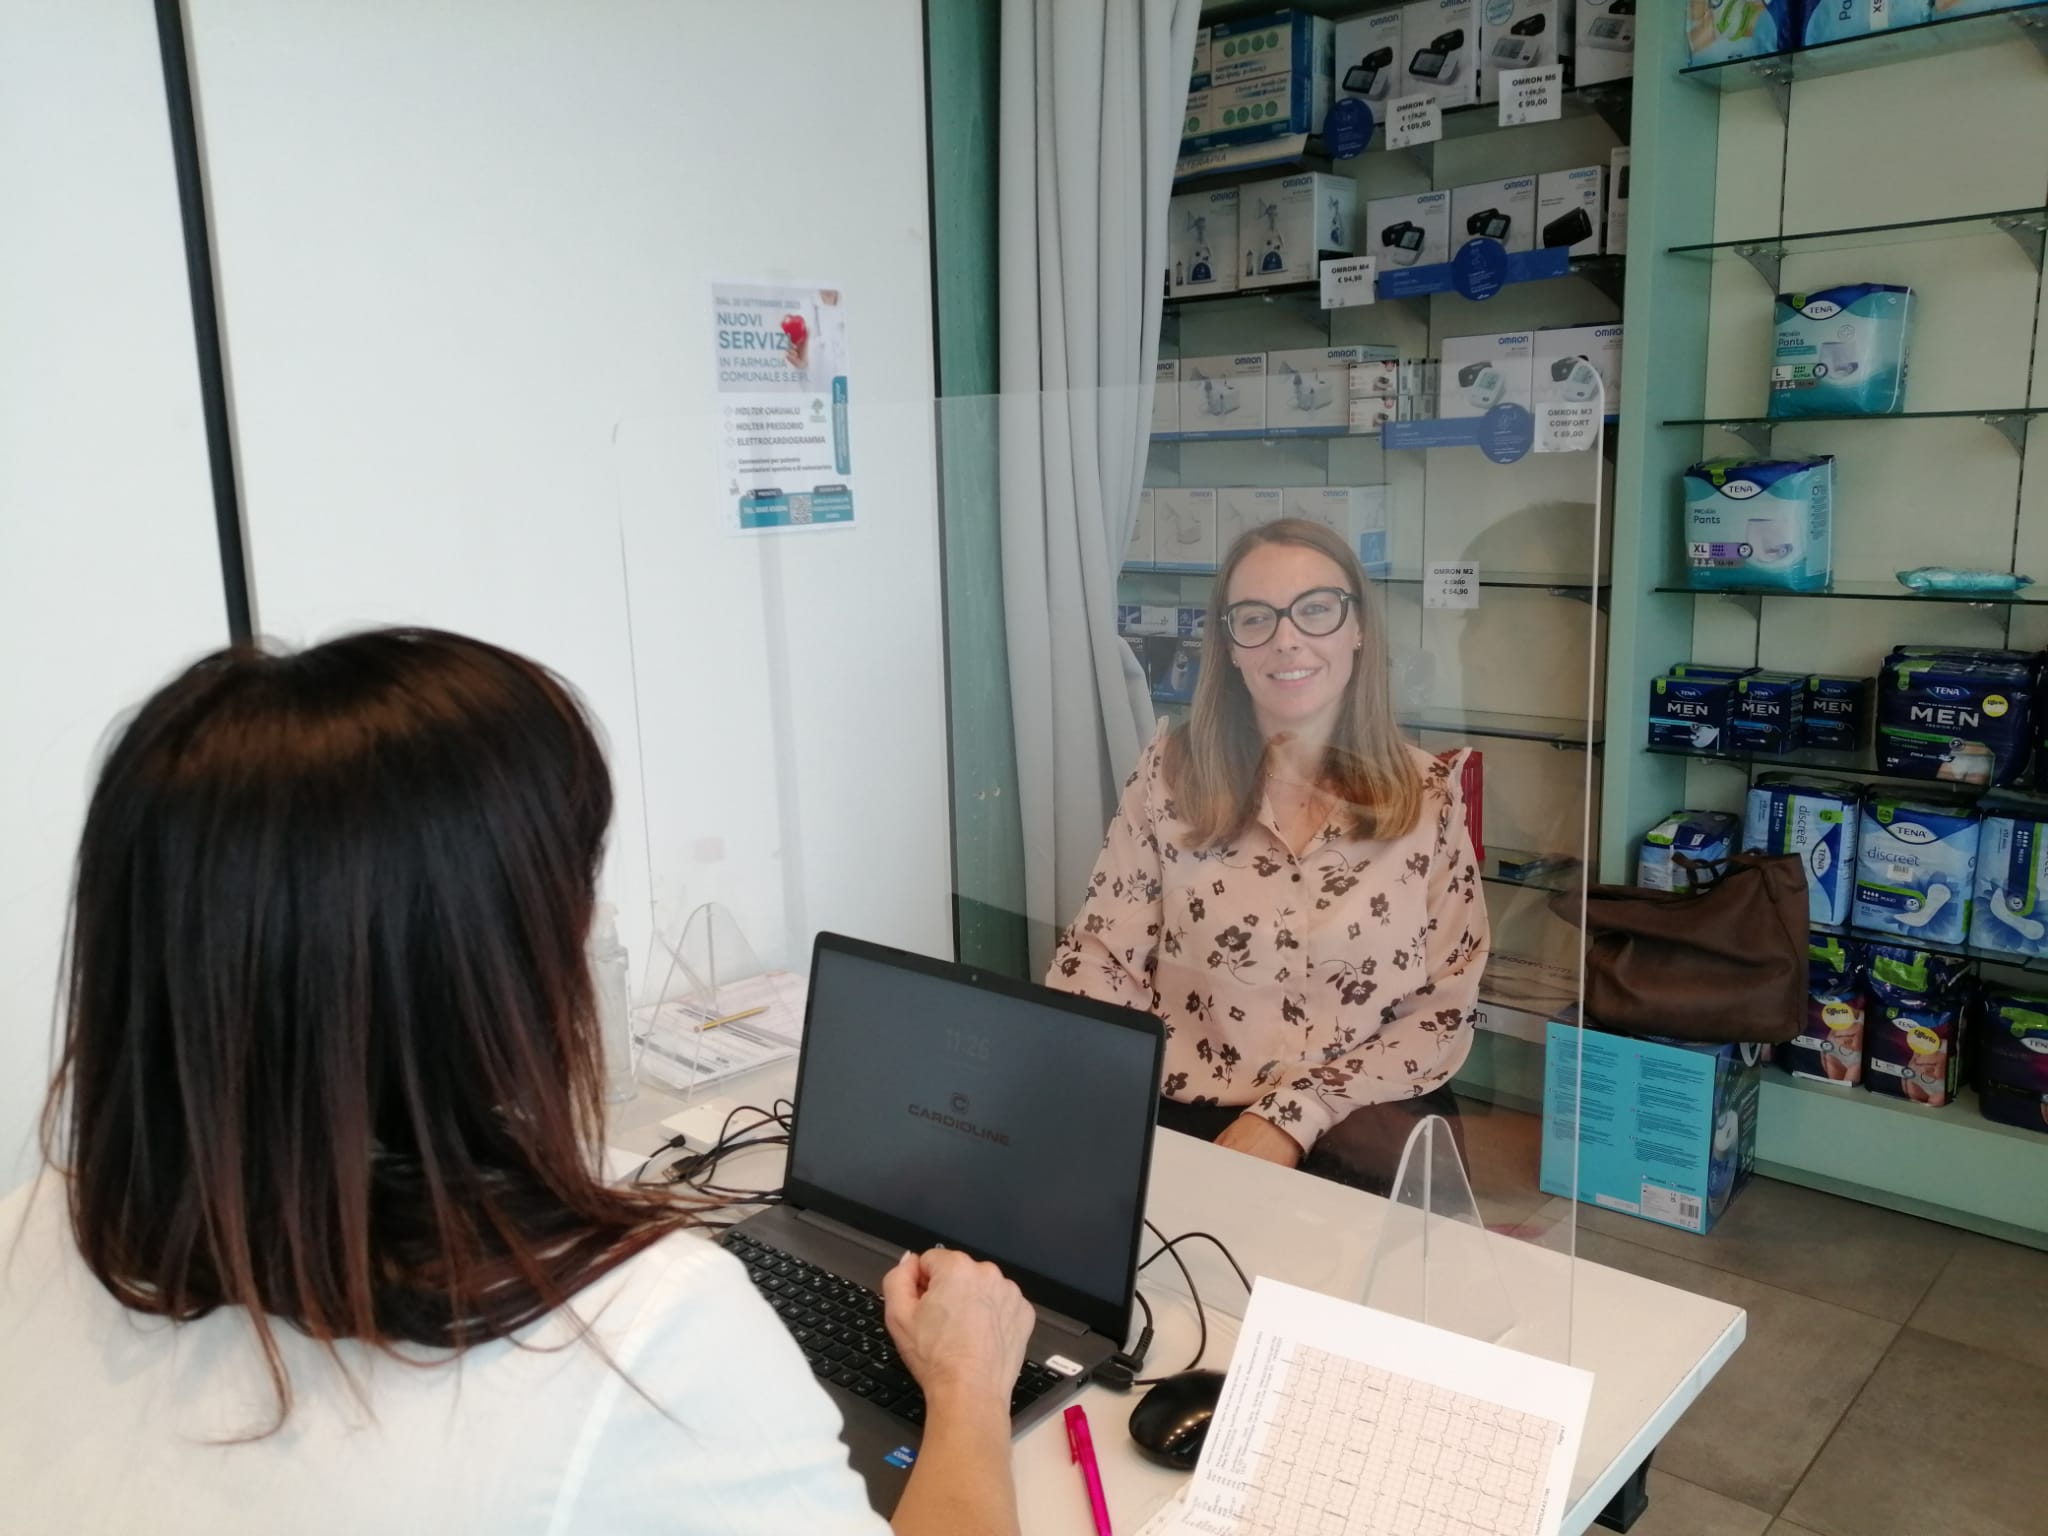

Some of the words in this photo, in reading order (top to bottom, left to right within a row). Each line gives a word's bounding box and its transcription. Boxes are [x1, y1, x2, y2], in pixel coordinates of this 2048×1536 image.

[1370, 14, 1399, 27] OMRON
[1512, 76, 1542, 86] OMRON
[1397, 101, 1424, 112] OMRON
[1525, 98, 1548, 108] 99,00
[1569, 169, 1598, 179] OMRON
[1282, 176, 1312, 188] OMRON
[1503, 179, 1533, 190] OMRON
[1210, 191, 1239, 202] OMRON
[1417, 193, 1445, 204] OMRON
[1331, 265, 1358, 274] OMRON
[1809, 305, 1833, 314] TENA
[718, 312, 762, 327] NUOVI
[1594, 328, 1623, 338] OMRO
[1498, 336, 1529, 345] OMRON
[1778, 338, 1805, 346] Pants
[1327, 349, 1357, 359] OMRON
[720, 357, 731, 368] IN
[734, 357, 788, 369] FARMACIA
[1234, 356, 1262, 366] OMRON
[720, 370, 780, 382] COMUNALE
[1547, 409, 1578, 417] OMRON
[1549, 418, 1590, 427] COMFORT
[1323, 489, 1349, 497] OMRON
[1729, 485, 1753, 493] TENA
[1694, 515, 1721, 524] Pants
[1694, 544, 1707, 553] XL
[1934, 686, 1960, 696] TENA
[1667, 702, 1708, 716] MEN
[1742, 702, 1780, 715] MEN
[1813, 700, 1853, 713] MEN
[1910, 705, 1980, 728] MEN
[1897, 826, 1927, 838] TENA
[1817, 848, 1826, 870] TENA
[1867, 846, 1920, 867] discreet
[908, 1103, 1010, 1147] CARDIOLINE
